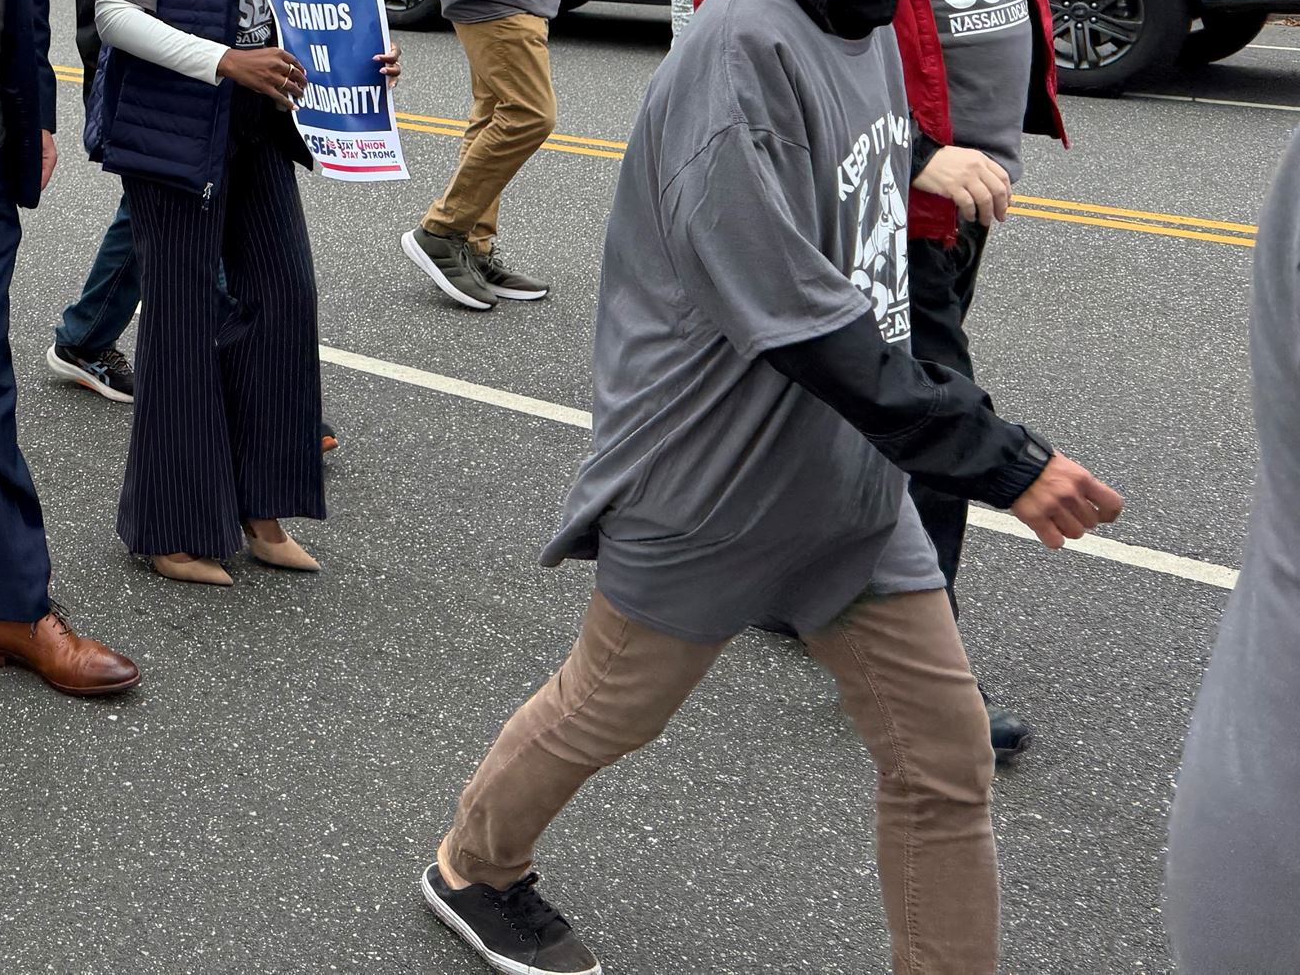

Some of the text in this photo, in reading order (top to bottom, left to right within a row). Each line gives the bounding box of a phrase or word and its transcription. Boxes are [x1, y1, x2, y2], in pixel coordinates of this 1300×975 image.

[283, 1, 353, 31] STANDS
[950, 9, 1006, 34] NASSAU
[310, 45, 331, 73] IN
[336, 138, 386, 150] STAY UNION
[341, 147, 396, 159] STAY STRONG
[837, 116, 885, 202] KEEP IT
